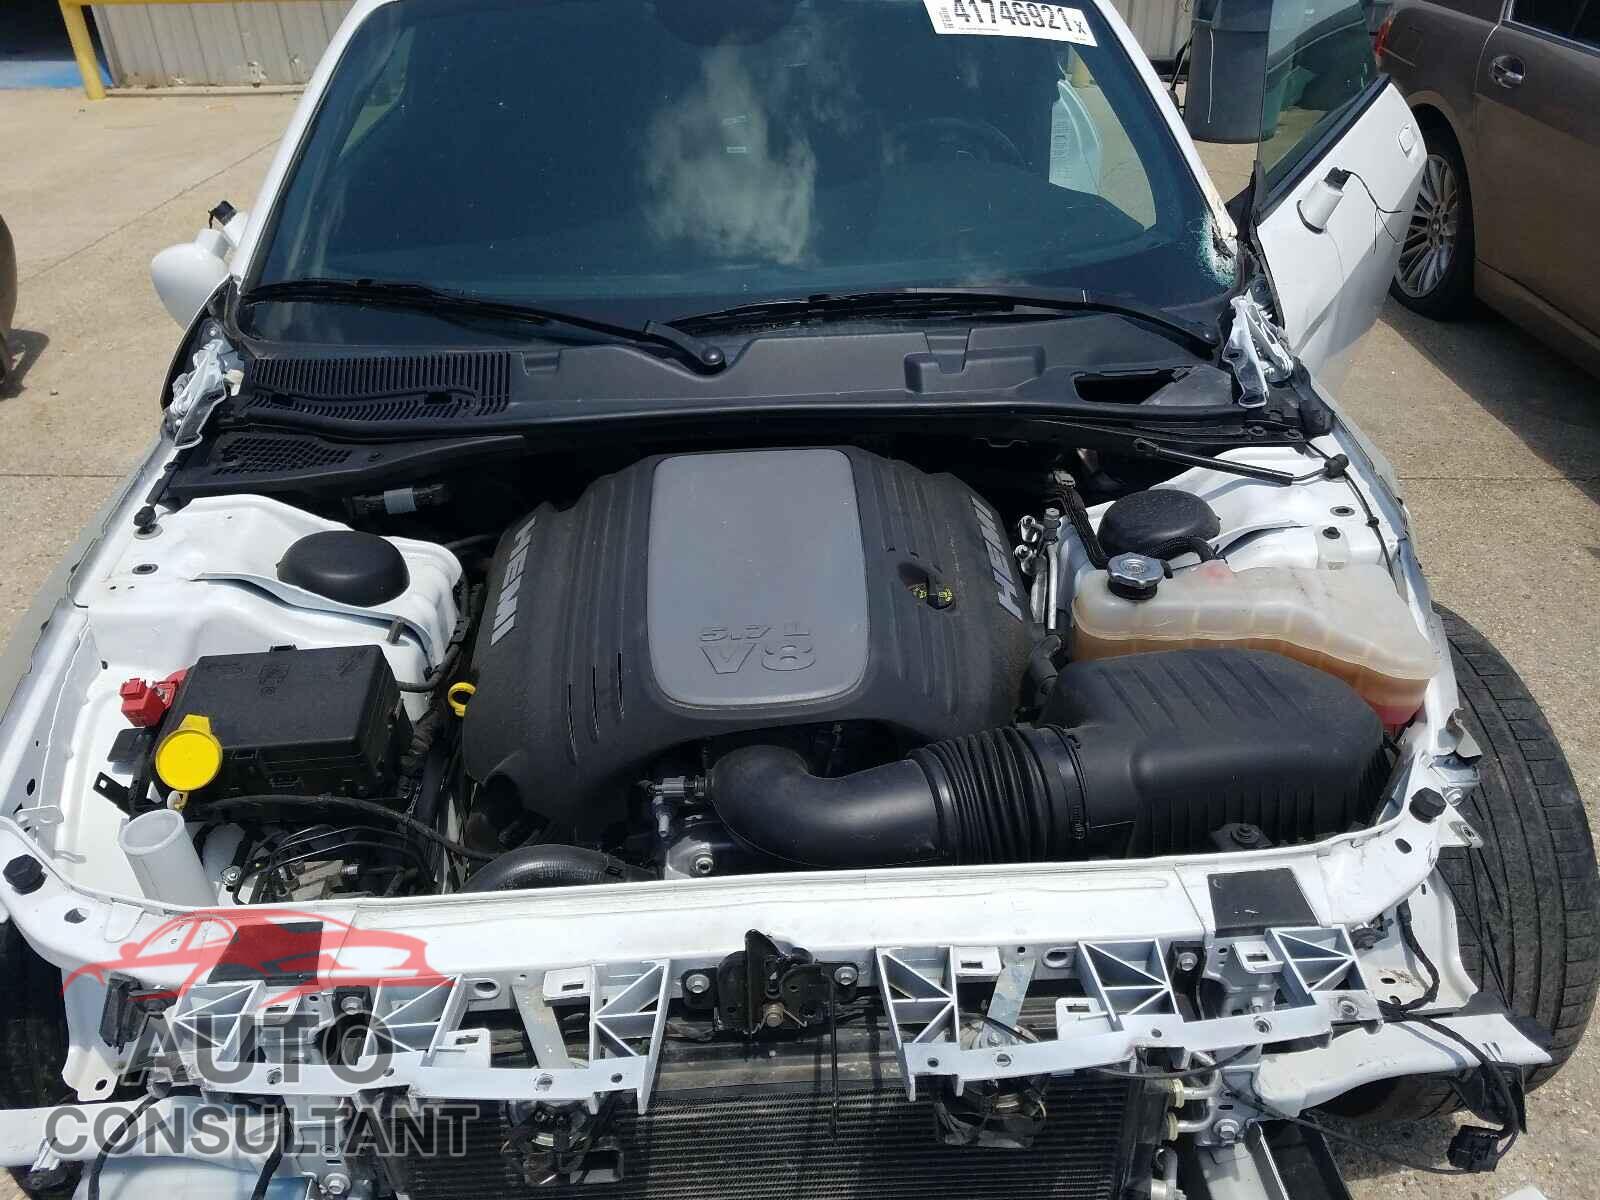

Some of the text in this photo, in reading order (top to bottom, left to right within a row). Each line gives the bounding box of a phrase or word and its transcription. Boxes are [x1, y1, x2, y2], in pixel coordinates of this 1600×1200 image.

[953, 0, 1073, 32] 41746921
[490, 515, 537, 647] HEMI
[969, 496, 1024, 624] HEMI
[697, 643, 817, 675] V8
